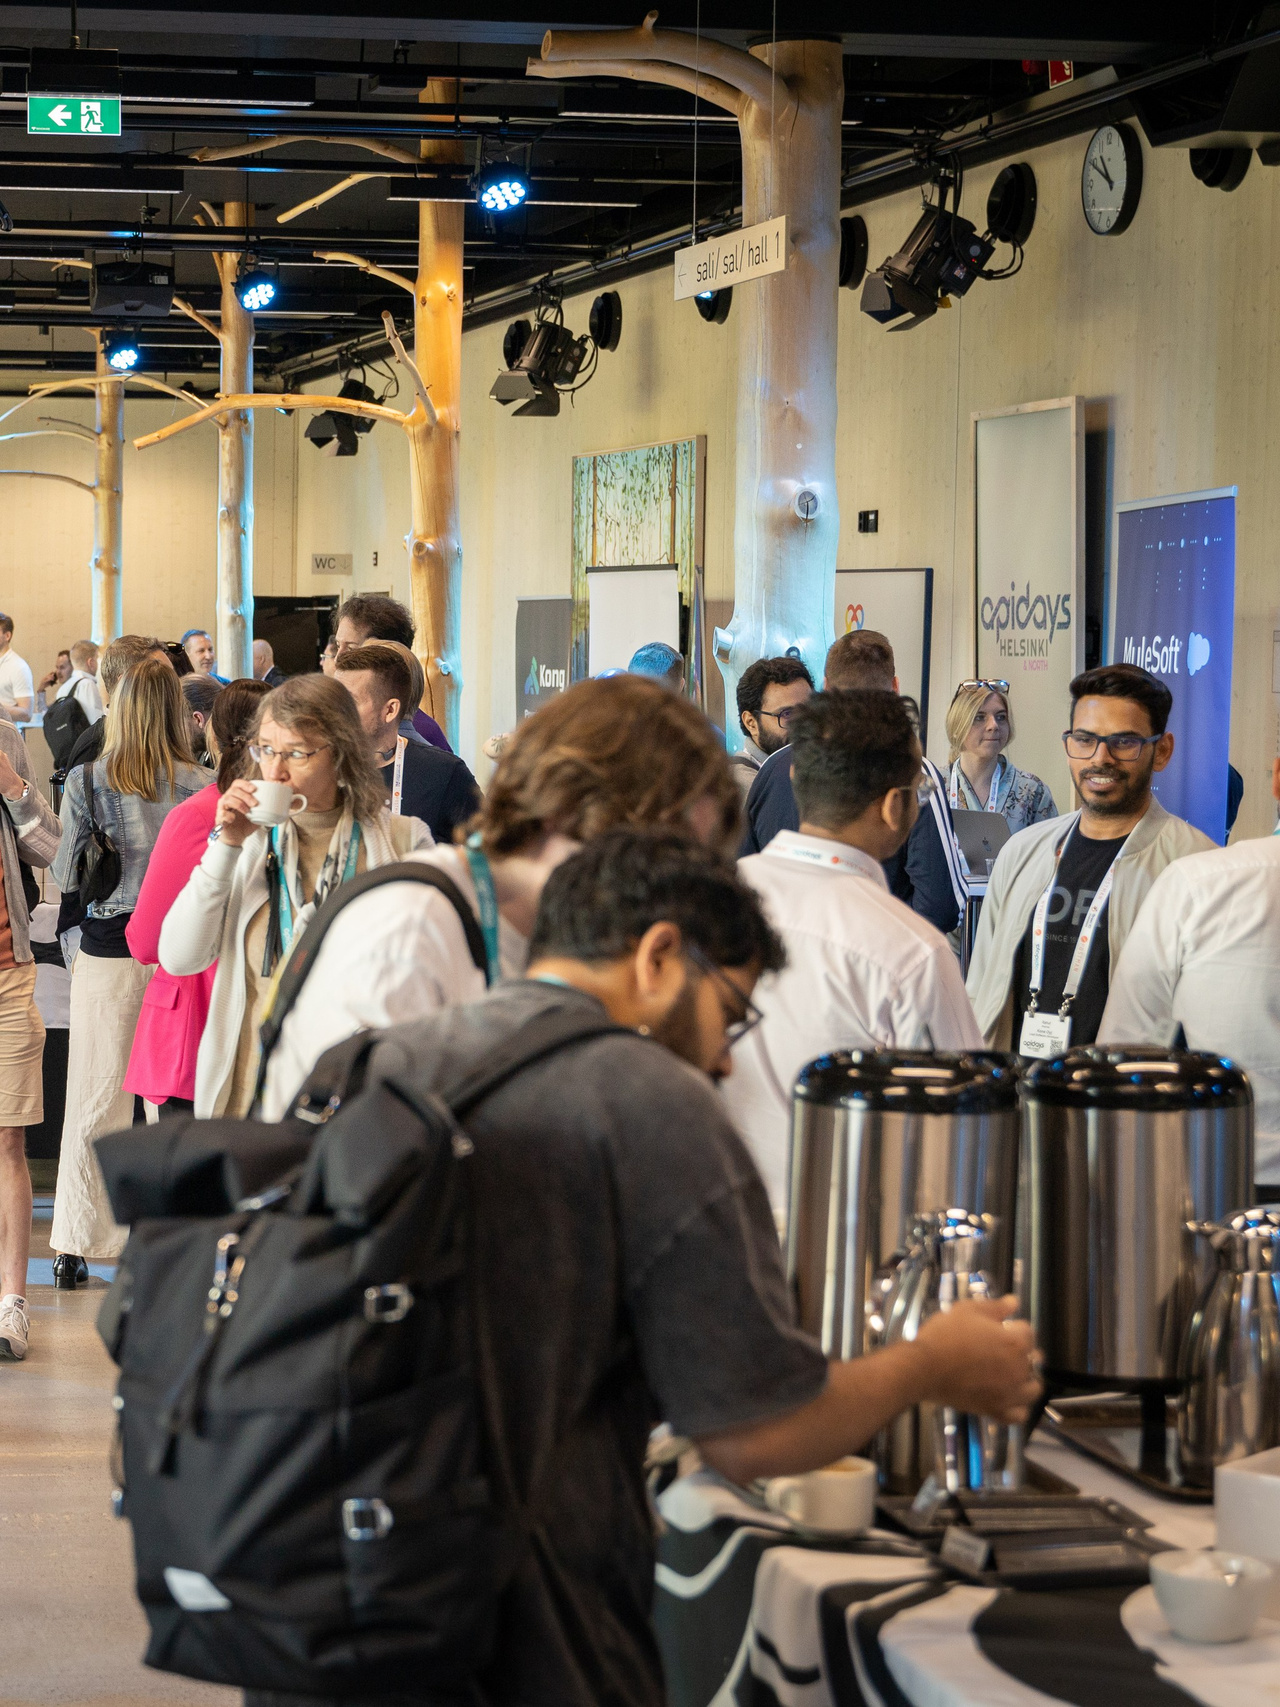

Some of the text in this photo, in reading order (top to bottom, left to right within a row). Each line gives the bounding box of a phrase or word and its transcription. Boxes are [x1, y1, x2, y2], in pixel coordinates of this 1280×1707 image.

[696, 231, 780, 282] sali/ sal/ hall 1
[314, 557, 336, 570] WC
[981, 580, 1071, 645] apidays
[1000, 638, 1048, 657] HELSINKI
[1122, 634, 1180, 674] MuleSoft
[540, 664, 566, 693] Kong
[1029, 660, 1048, 671] NORTH
